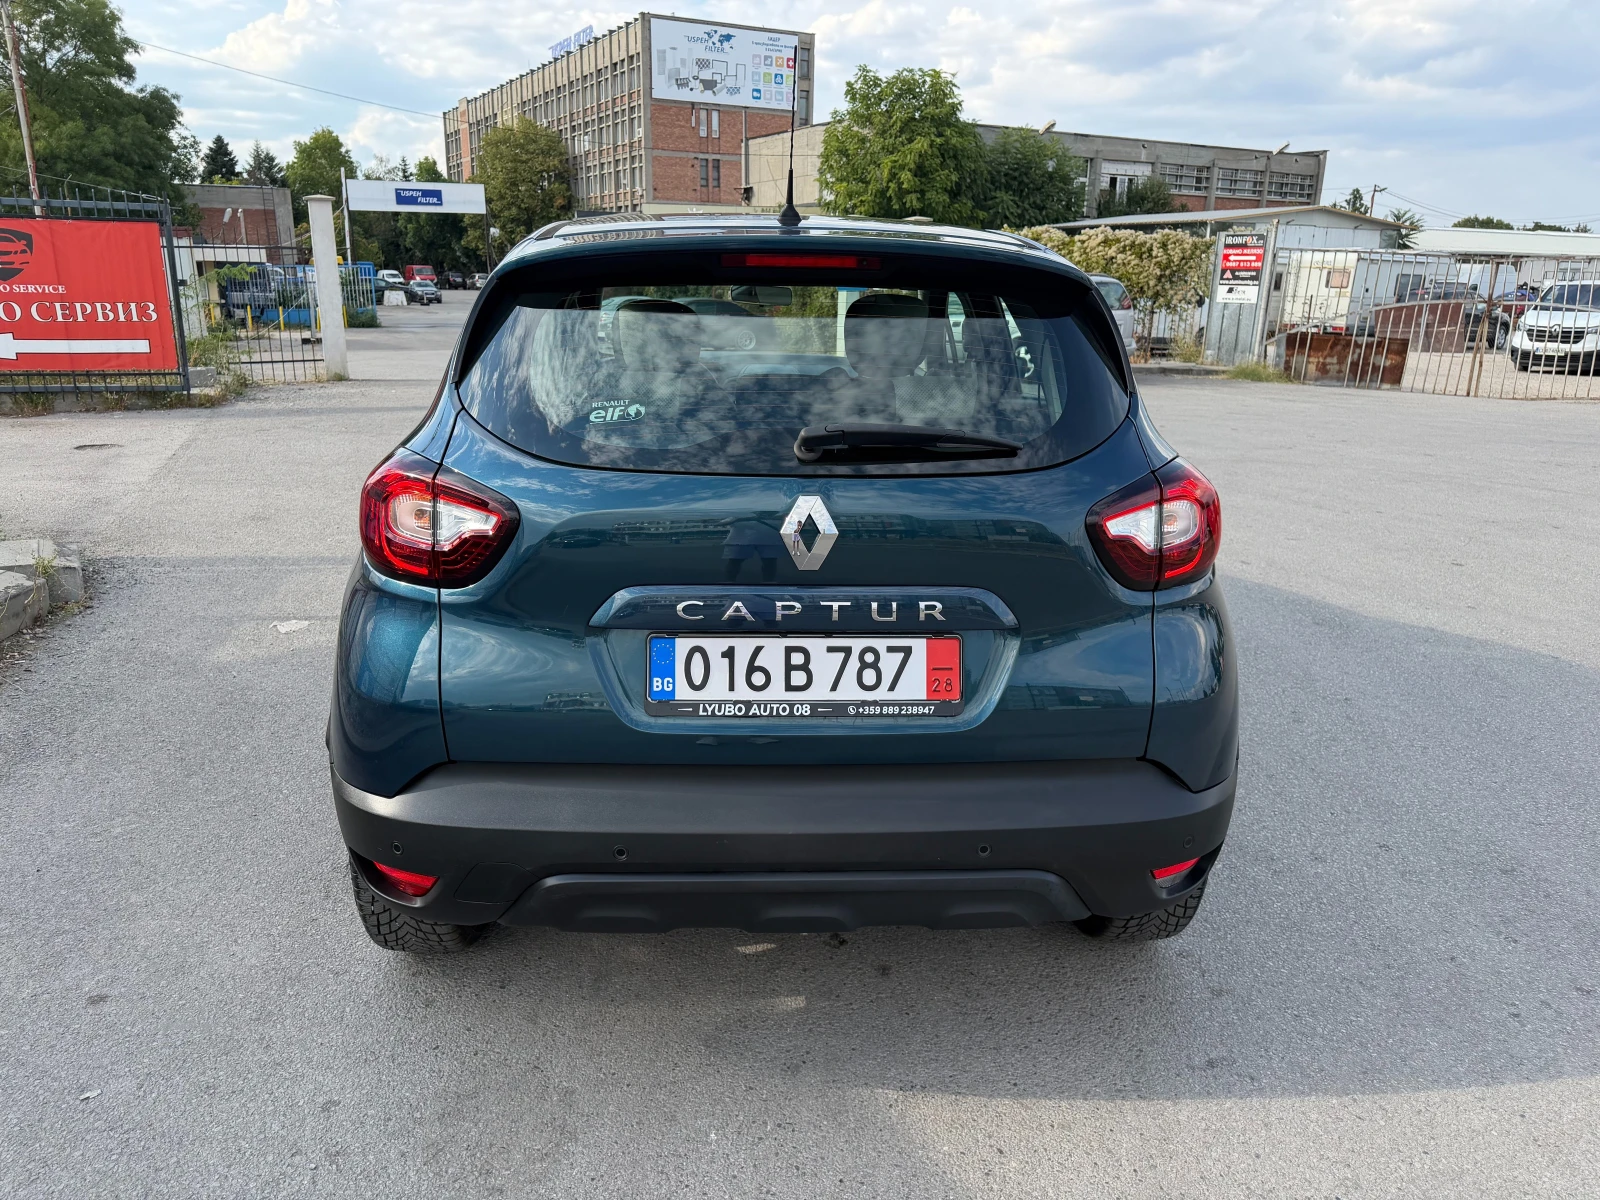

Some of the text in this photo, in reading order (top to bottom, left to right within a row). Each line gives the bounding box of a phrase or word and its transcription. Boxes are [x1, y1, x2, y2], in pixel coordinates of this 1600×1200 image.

[687, 36, 709, 44] USPEH
[705, 45, 726, 53] FILTER
[12, 284, 67, 294] SERVICE
[30, 301, 158, 323] СЕРВИЗ
[590, 407, 625, 421] elf
[676, 600, 947, 622] CAPTUR
[653, 677, 674, 692] BG
[931, 678, 954, 693] 28
[699, 703, 811, 716] LYUBO AUTO 08
[858, 706, 935, 715] +359 889 238947
